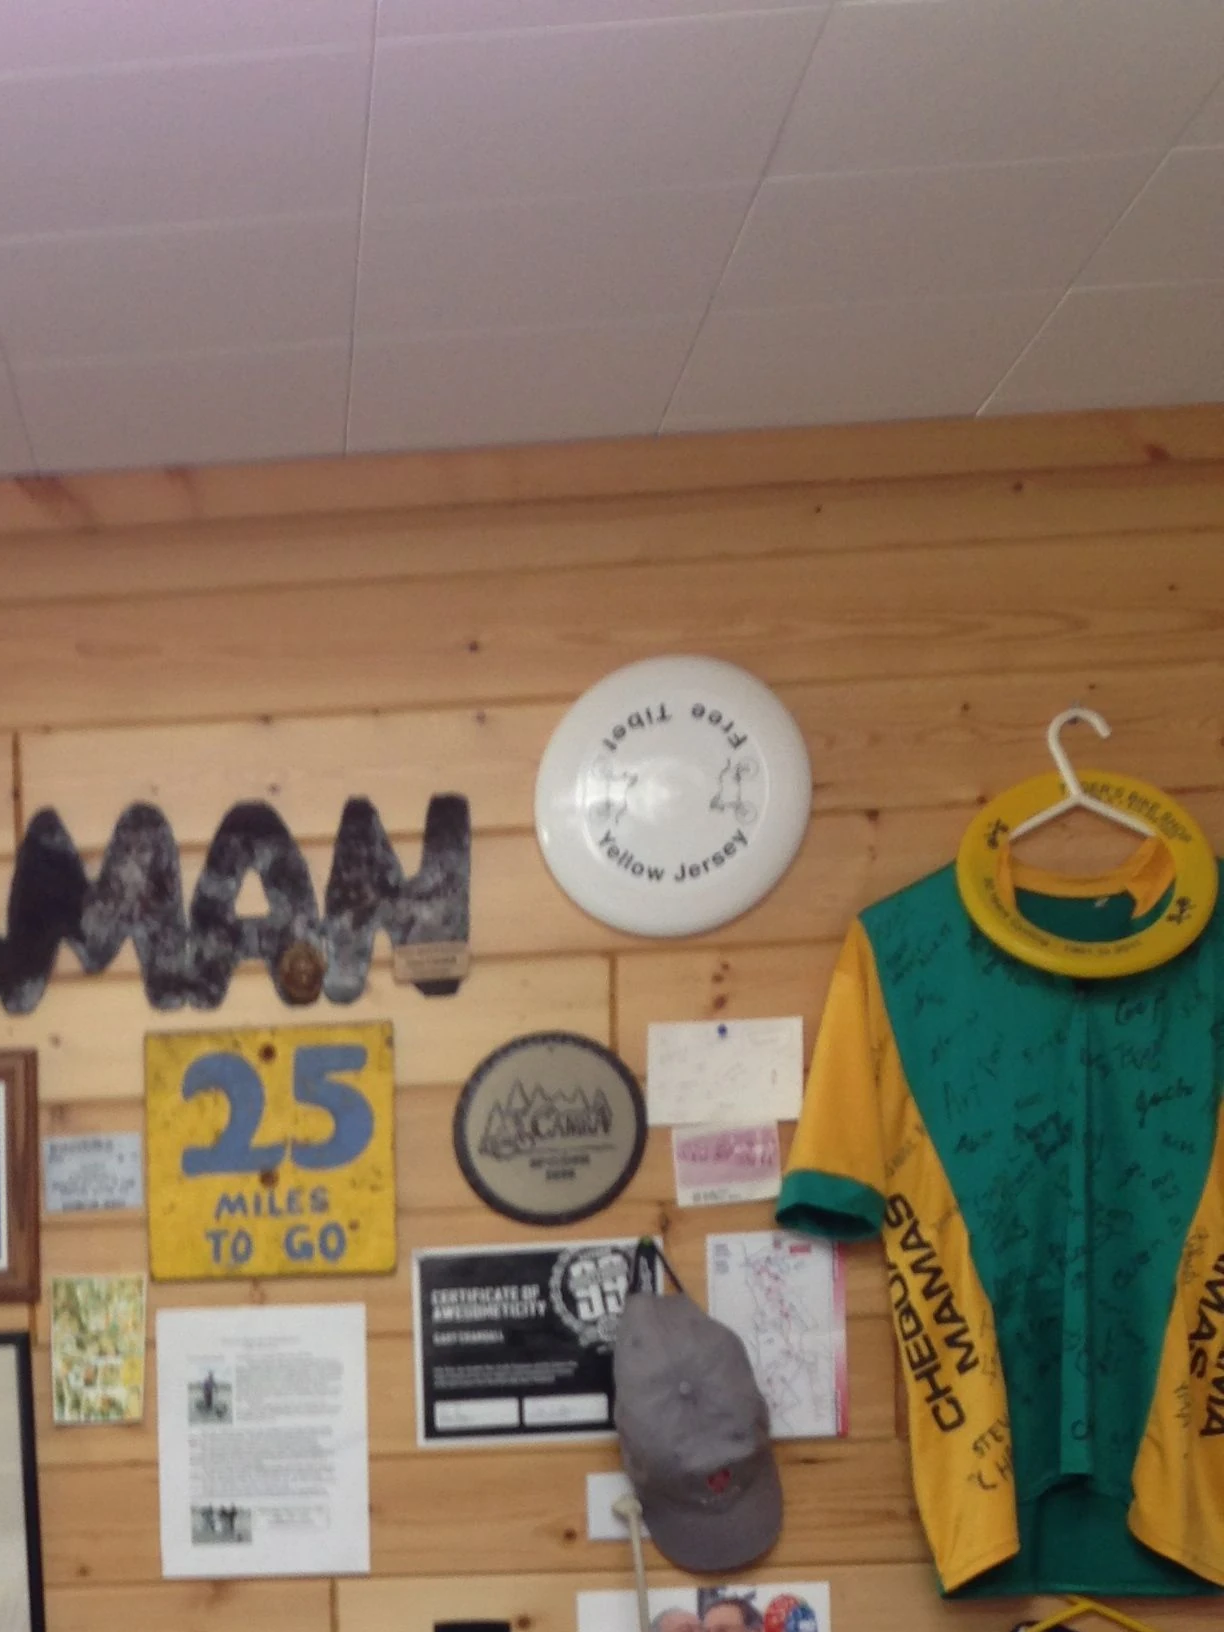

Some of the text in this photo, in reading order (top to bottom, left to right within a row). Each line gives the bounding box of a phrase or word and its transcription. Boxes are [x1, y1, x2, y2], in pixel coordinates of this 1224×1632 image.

[690, 702, 749, 750] Free
[599, 828, 749, 882] Yellow Jersey
[180, 1044, 375, 1178] 25
[214, 1185, 330, 1221] MILES
[204, 1221, 347, 1265] TO GO
[430, 1283, 541, 1304] CERTIFICATE OF
[884, 1193, 980, 1375] MAMAS
